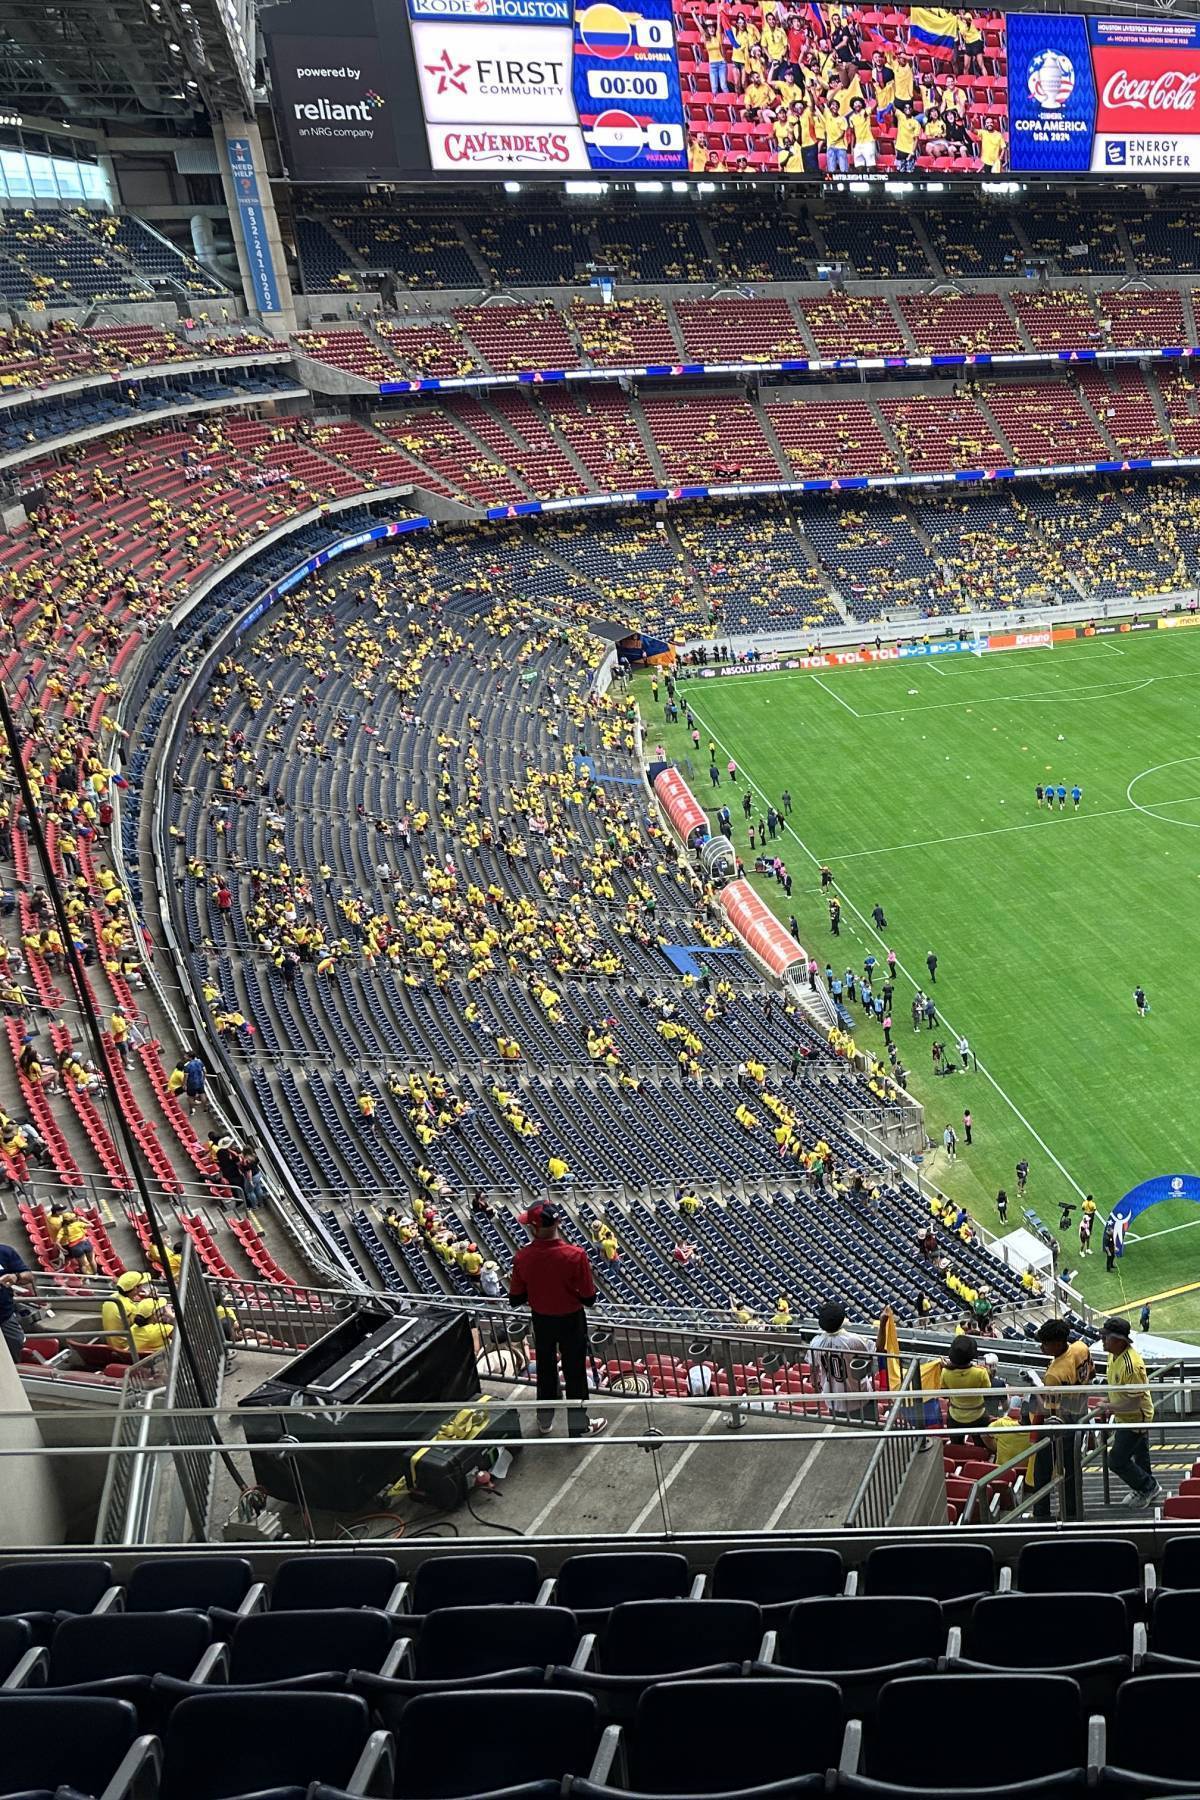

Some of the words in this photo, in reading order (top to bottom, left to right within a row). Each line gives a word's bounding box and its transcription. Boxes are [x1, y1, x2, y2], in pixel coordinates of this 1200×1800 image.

[493, 0, 569, 18] HOUSTON
[649, 26, 661, 43] 0
[634, 52, 671, 62] COLOMBIA
[297, 66, 344, 79] powered
[345, 67, 361, 80] by
[476, 60, 563, 85] FIRST
[480, 85, 564, 96] COMMUNITY
[600, 77, 657, 95] 00:00
[294, 97, 372, 121] reliant
[1015, 120, 1042, 131] COPA
[1043, 121, 1087, 131] AMERICA
[298, 128, 309, 136] an
[310, 127, 332, 137] NRG
[334, 129, 374, 139] company
[660, 130, 671, 146] 0
[1033, 132, 1049, 141] USA
[1050, 132, 1070, 141] 2024
[444, 132, 570, 163] CAVENDER'S
[1129, 140, 1178, 152] ENERGY
[1130, 155, 1190, 167] TRANSFER
[1016, 634, 1050, 645] Betano
[899, 646, 926, 657] BYD
[929, 643, 955, 653] BYD
[802, 657, 831, 667] TCL
[836, 653, 863, 664] TCL
[871, 649, 899, 660] TCL
[721, 664, 755, 676] ABSOLUT
[755, 662, 780, 673] SPORT
